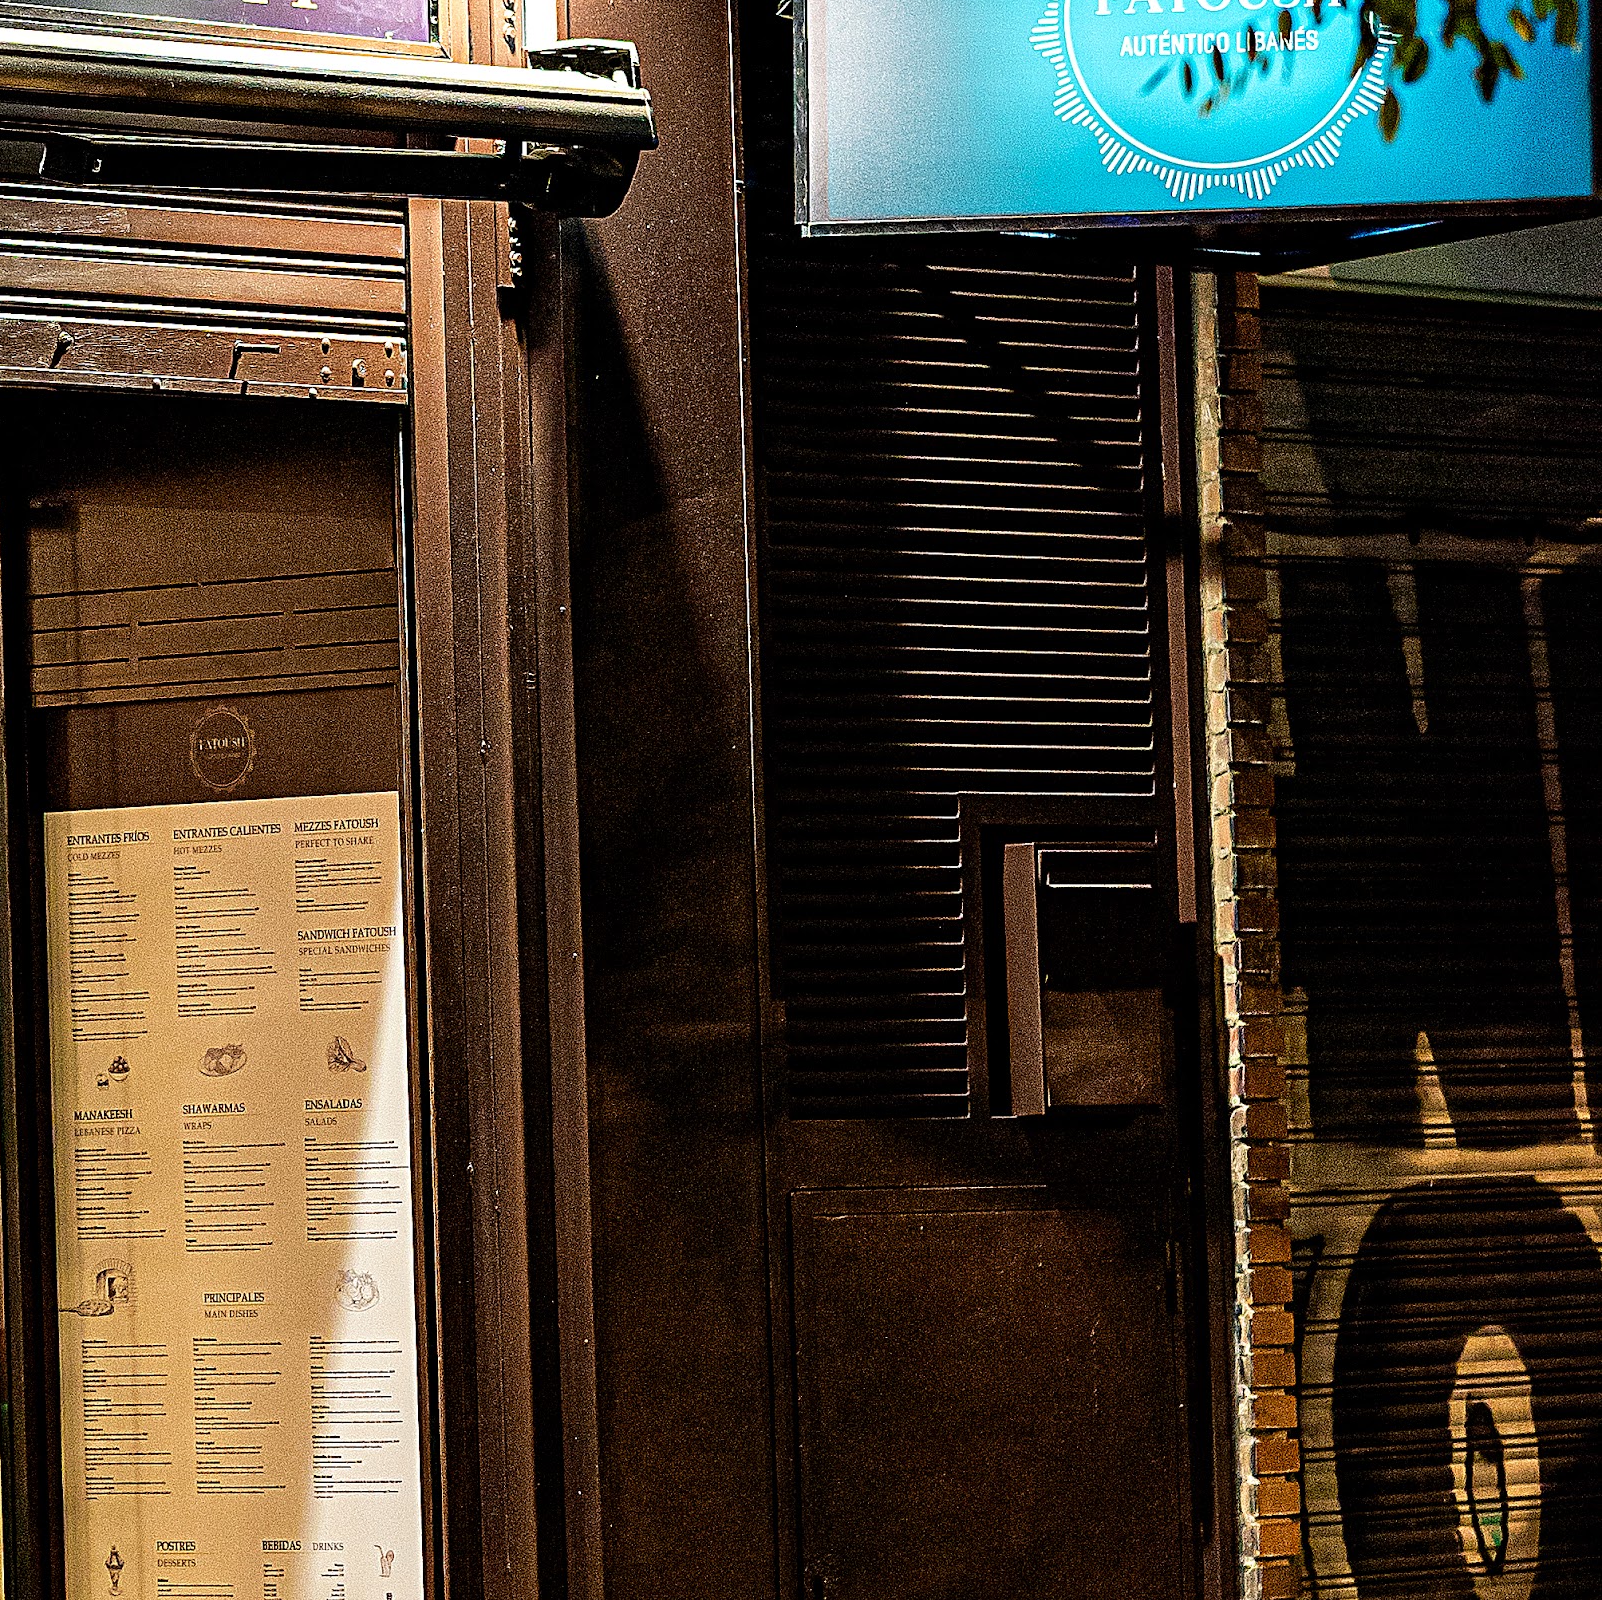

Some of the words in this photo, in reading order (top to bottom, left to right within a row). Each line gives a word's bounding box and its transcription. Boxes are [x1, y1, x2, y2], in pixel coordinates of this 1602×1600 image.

[1119, 30, 1230, 57] AUTÉNTICO
[294, 820, 332, 832] MEZZES
[334, 818, 379, 830] FATOUSH
[67, 833, 121, 846] ENTRANTES
[123, 829, 150, 843] FRÍOS
[173, 827, 228, 840] ENTRANTES
[230, 823, 282, 836] CALIENTES
[295, 839, 330, 849] PERFECT
[333, 837, 345, 847] TO
[346, 836, 374, 846] SHARE
[173, 846, 190, 855] HOT
[297, 928, 350, 941] SANDWICH
[353, 926, 397, 938] FATOUSH
[298, 946, 333, 956] SPECIAL
[335, 944, 391, 955] SANDWICHES
[182, 1102, 246, 1115] SHAWARMAS
[304, 1098, 363, 1111] ENSALADAS
[74, 1108, 133, 1120] MANAKEESH
[183, 1121, 212, 1130] WRAPS
[304, 1116, 338, 1126] SALADS
[116, 1126, 141, 1136] PIZZA
[203, 1291, 265, 1304] PRINCIPALES
[204, 1309, 226, 1319] MAIN
[229, 1309, 258, 1318] DISHES
[156, 1540, 196, 1552] POSTRES
[262, 1540, 302, 1551] BEBIDAS
[312, 1542, 344, 1551] DRINKS
[157, 1558, 196, 1568] DESSERTS
